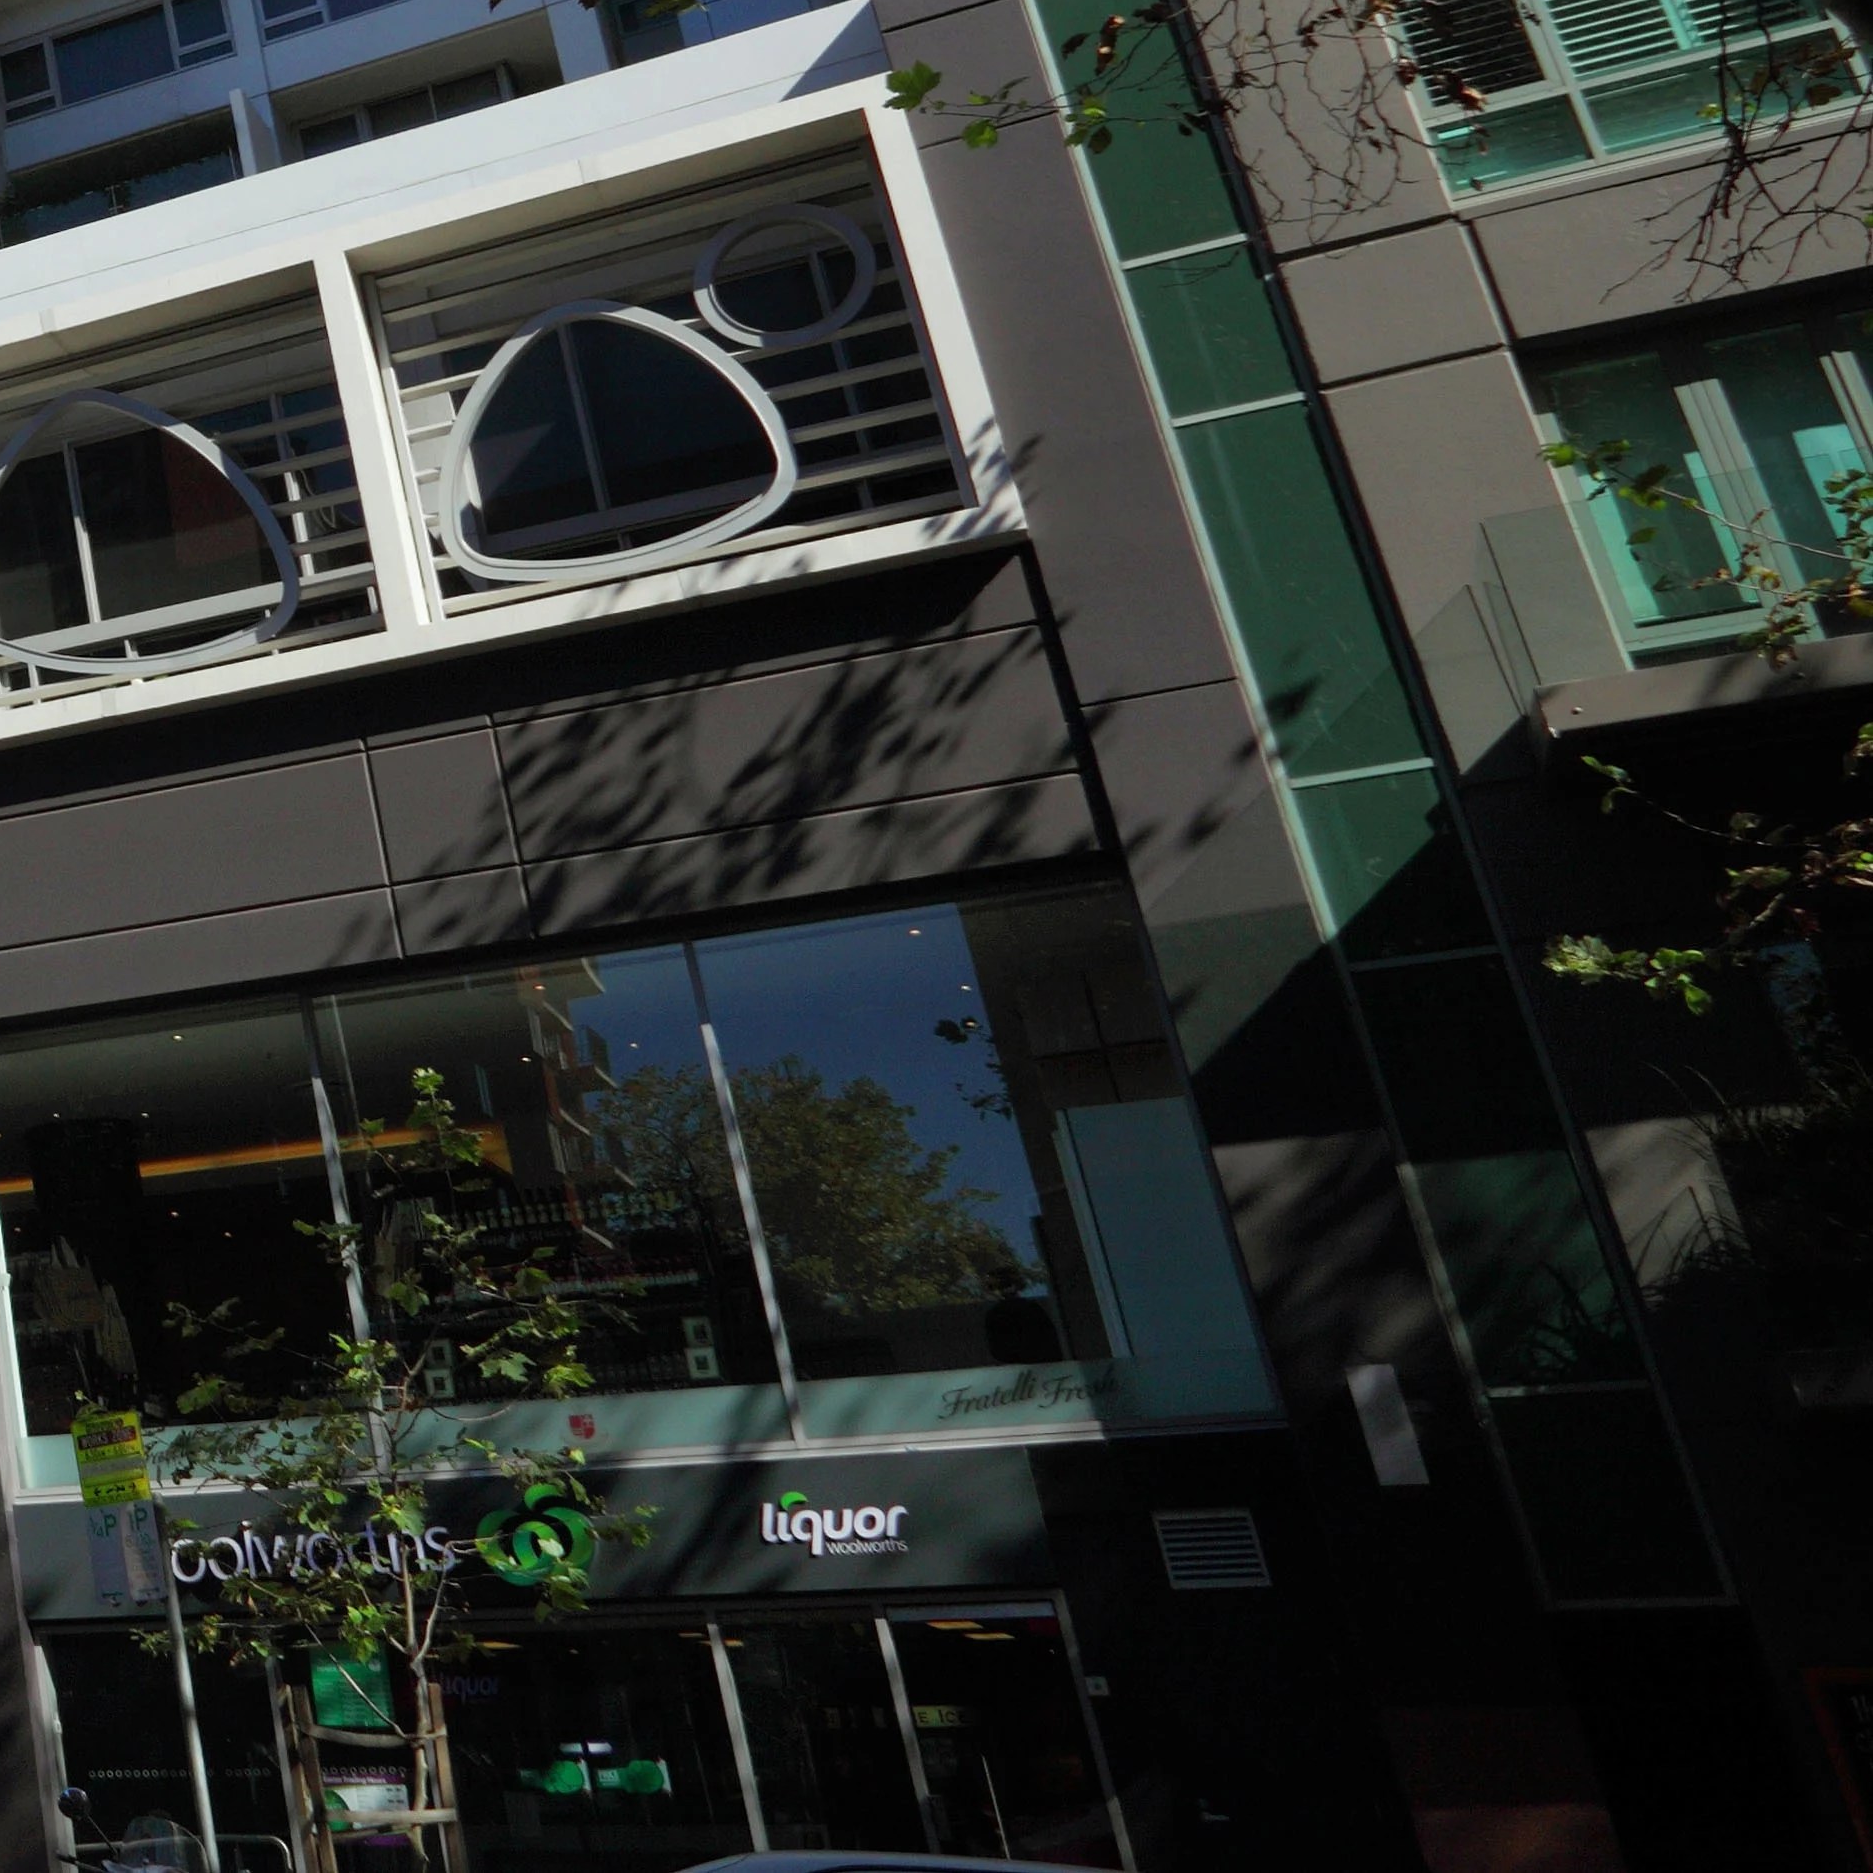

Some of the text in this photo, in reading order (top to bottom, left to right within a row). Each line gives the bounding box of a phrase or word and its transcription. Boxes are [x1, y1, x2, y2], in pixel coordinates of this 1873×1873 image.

[938, 1369, 1037, 1420] Fratelli
[762, 1491, 909, 1556] liquor
[826, 1539, 909, 1556] woolworths
